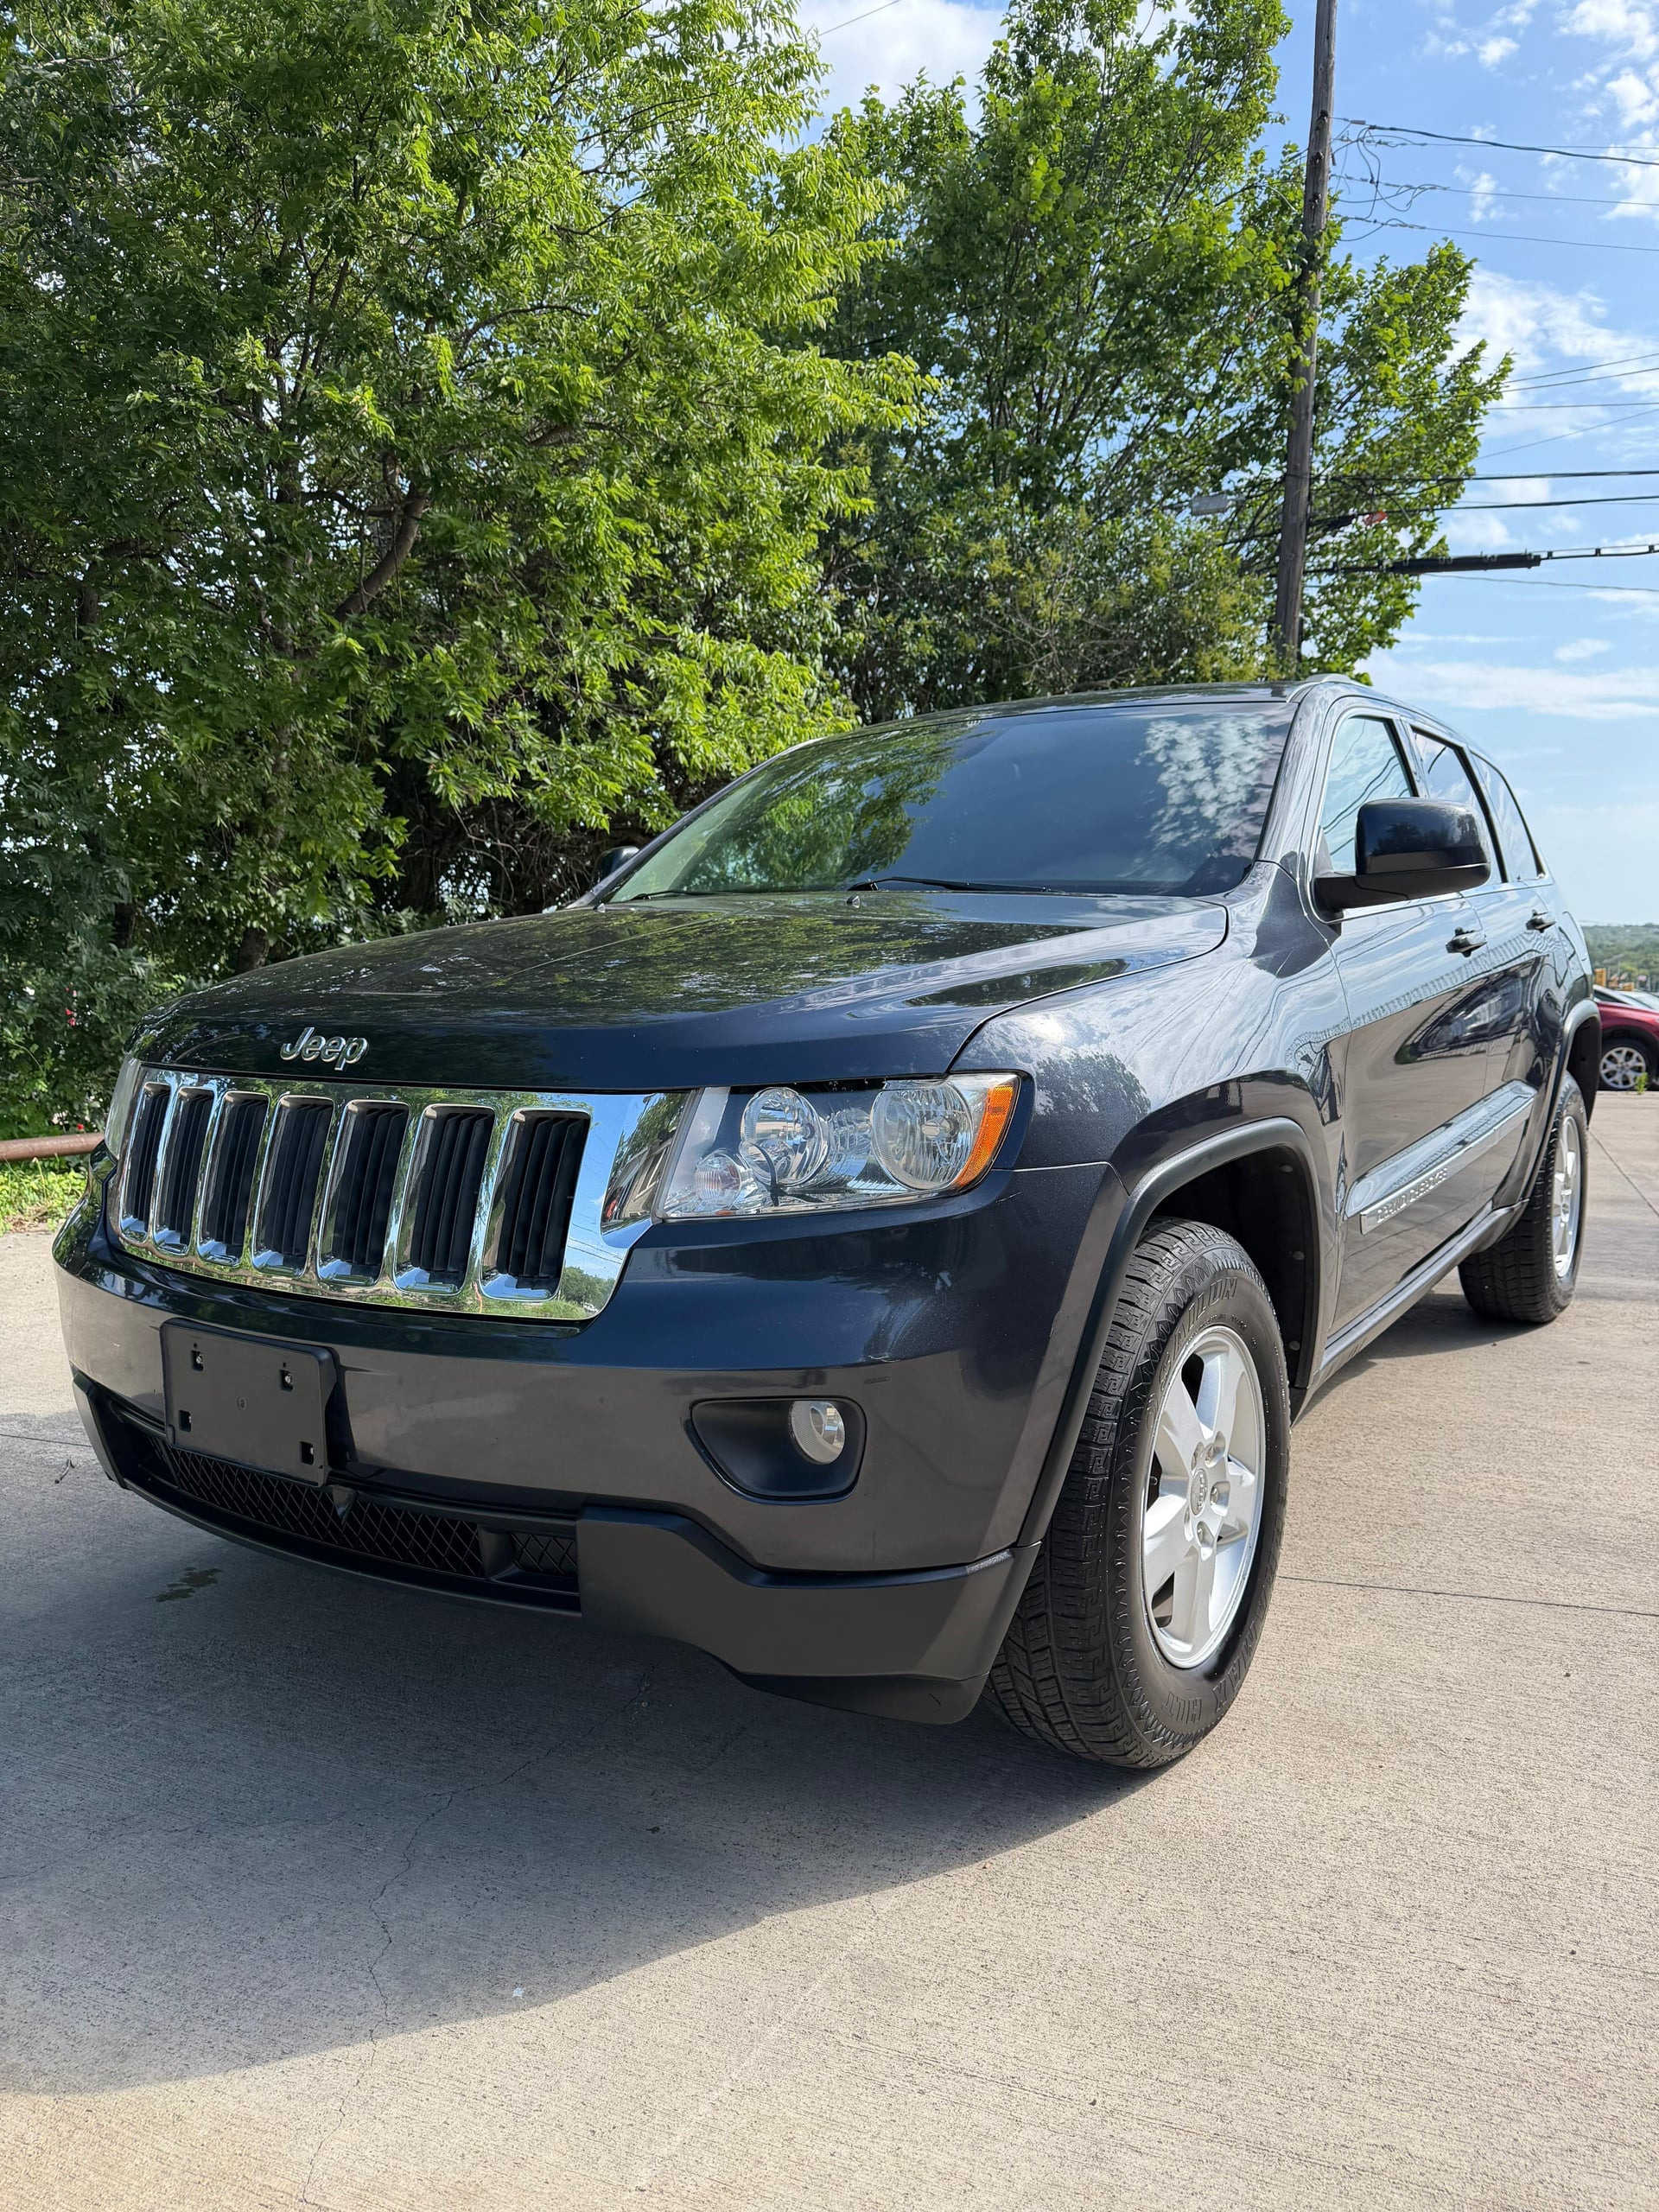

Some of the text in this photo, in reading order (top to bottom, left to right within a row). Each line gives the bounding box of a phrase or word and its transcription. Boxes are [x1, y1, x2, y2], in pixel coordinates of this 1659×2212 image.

[280, 1027, 369, 1071] Jeep
[1377, 1168, 1447, 1224] GRAND CHEROKEE
[1160, 1276, 1238, 1391] SAILUN
